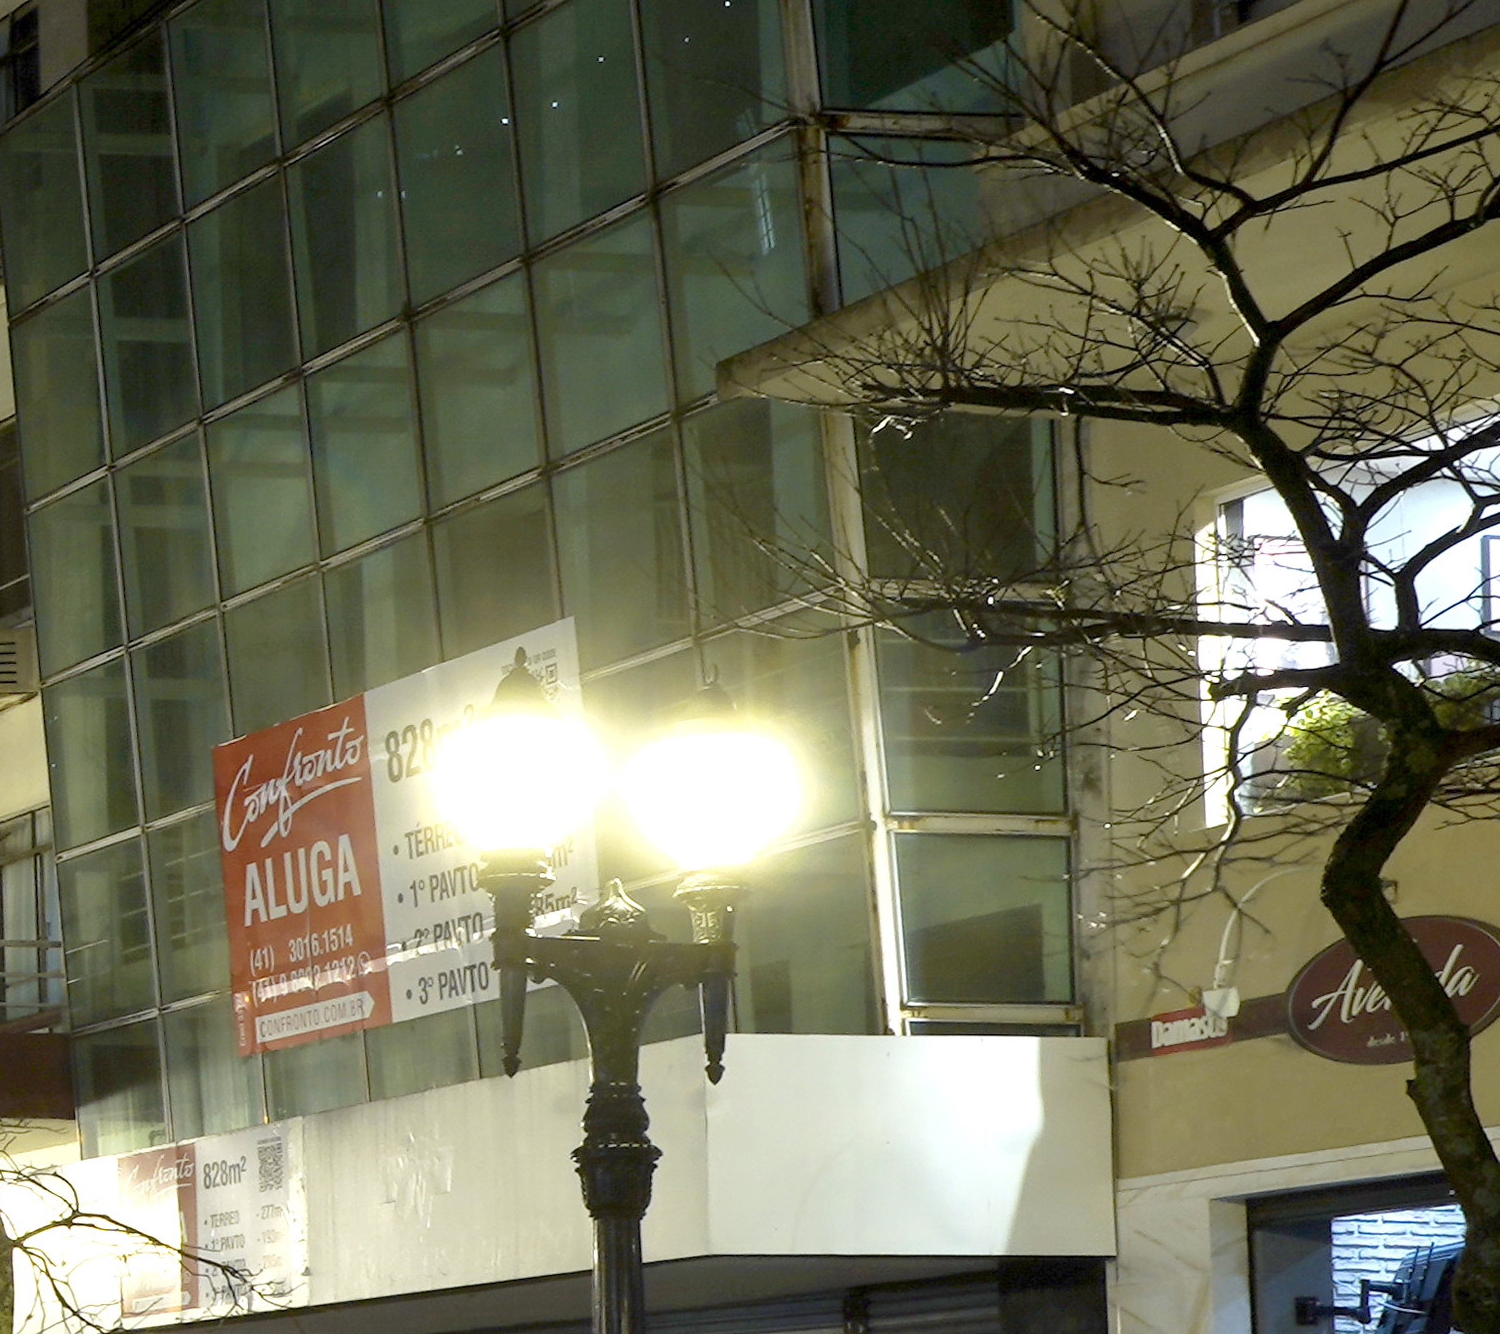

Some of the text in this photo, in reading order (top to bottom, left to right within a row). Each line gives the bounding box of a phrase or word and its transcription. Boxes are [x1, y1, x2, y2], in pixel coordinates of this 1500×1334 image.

[222, 716, 364, 852] Confronto
[243, 833, 362, 927] ALUGA
[429, 862, 479, 903] PAVTO
[250, 923, 353, 977] (41) 3016.1514
[433, 911, 484, 951] PAVTO
[438, 961, 490, 1001] PAVTO
[1307, 943, 1480, 1030] Aveda
[203, 1155, 247, 1190] 828m²
